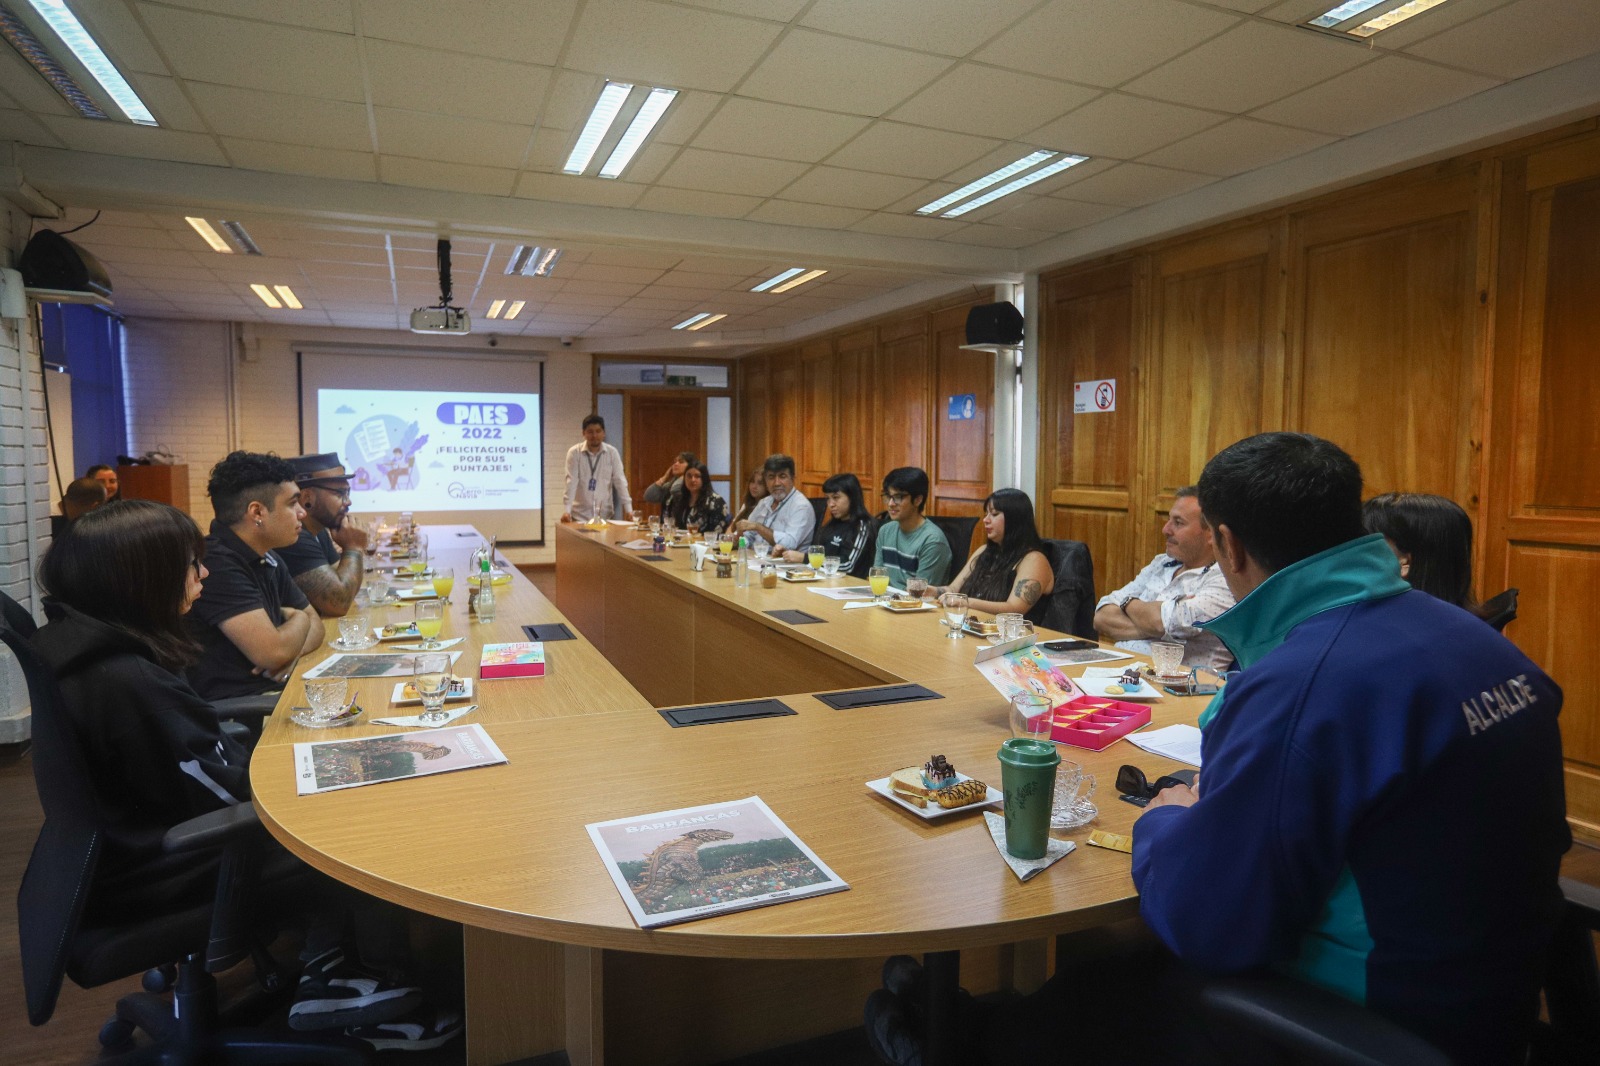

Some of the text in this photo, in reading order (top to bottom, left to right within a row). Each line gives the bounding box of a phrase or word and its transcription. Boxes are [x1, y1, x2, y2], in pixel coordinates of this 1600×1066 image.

[454, 405, 509, 425] PAES
[462, 427, 502, 439] 2022
[436, 446, 528, 454] ¡FELICITACIONES
[460, 455, 506, 463] POR SUS
[1462, 674, 1538, 735] ALCALDE
[625, 810, 741, 833] BARRANCAS
